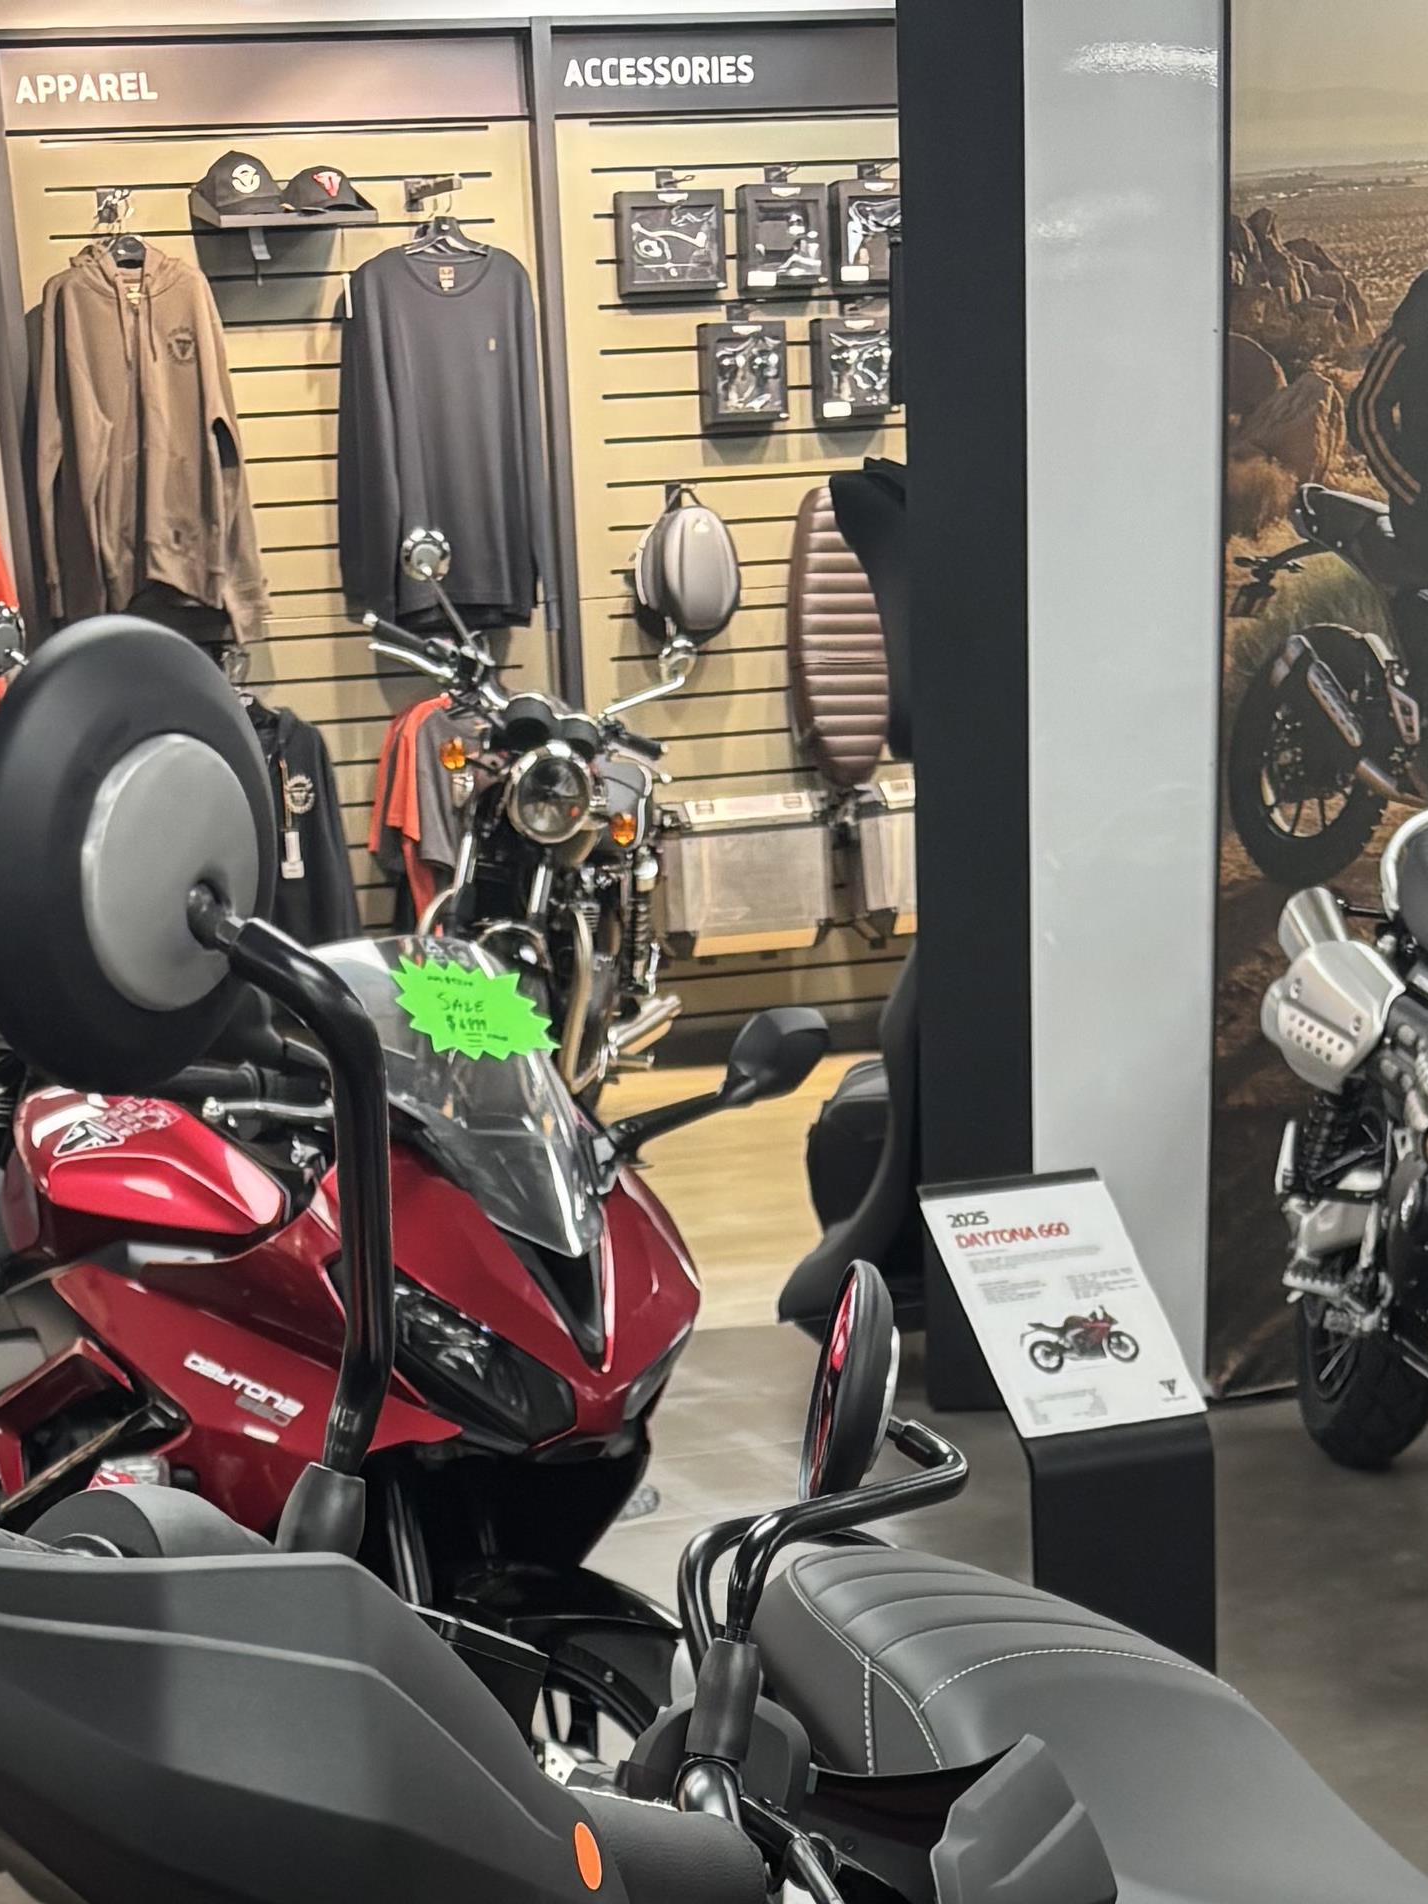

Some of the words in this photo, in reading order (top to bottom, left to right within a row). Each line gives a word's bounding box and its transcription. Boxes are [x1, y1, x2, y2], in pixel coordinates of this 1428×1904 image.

[564, 54, 756, 87] ACCESSORIES
[15, 72, 158, 104] APPAREL
[437, 992, 485, 1013] SALE
[947, 1211, 990, 1228] 2025
[955, 1227, 1038, 1249] DAYTONA
[1038, 1222, 1070, 1238] 660
